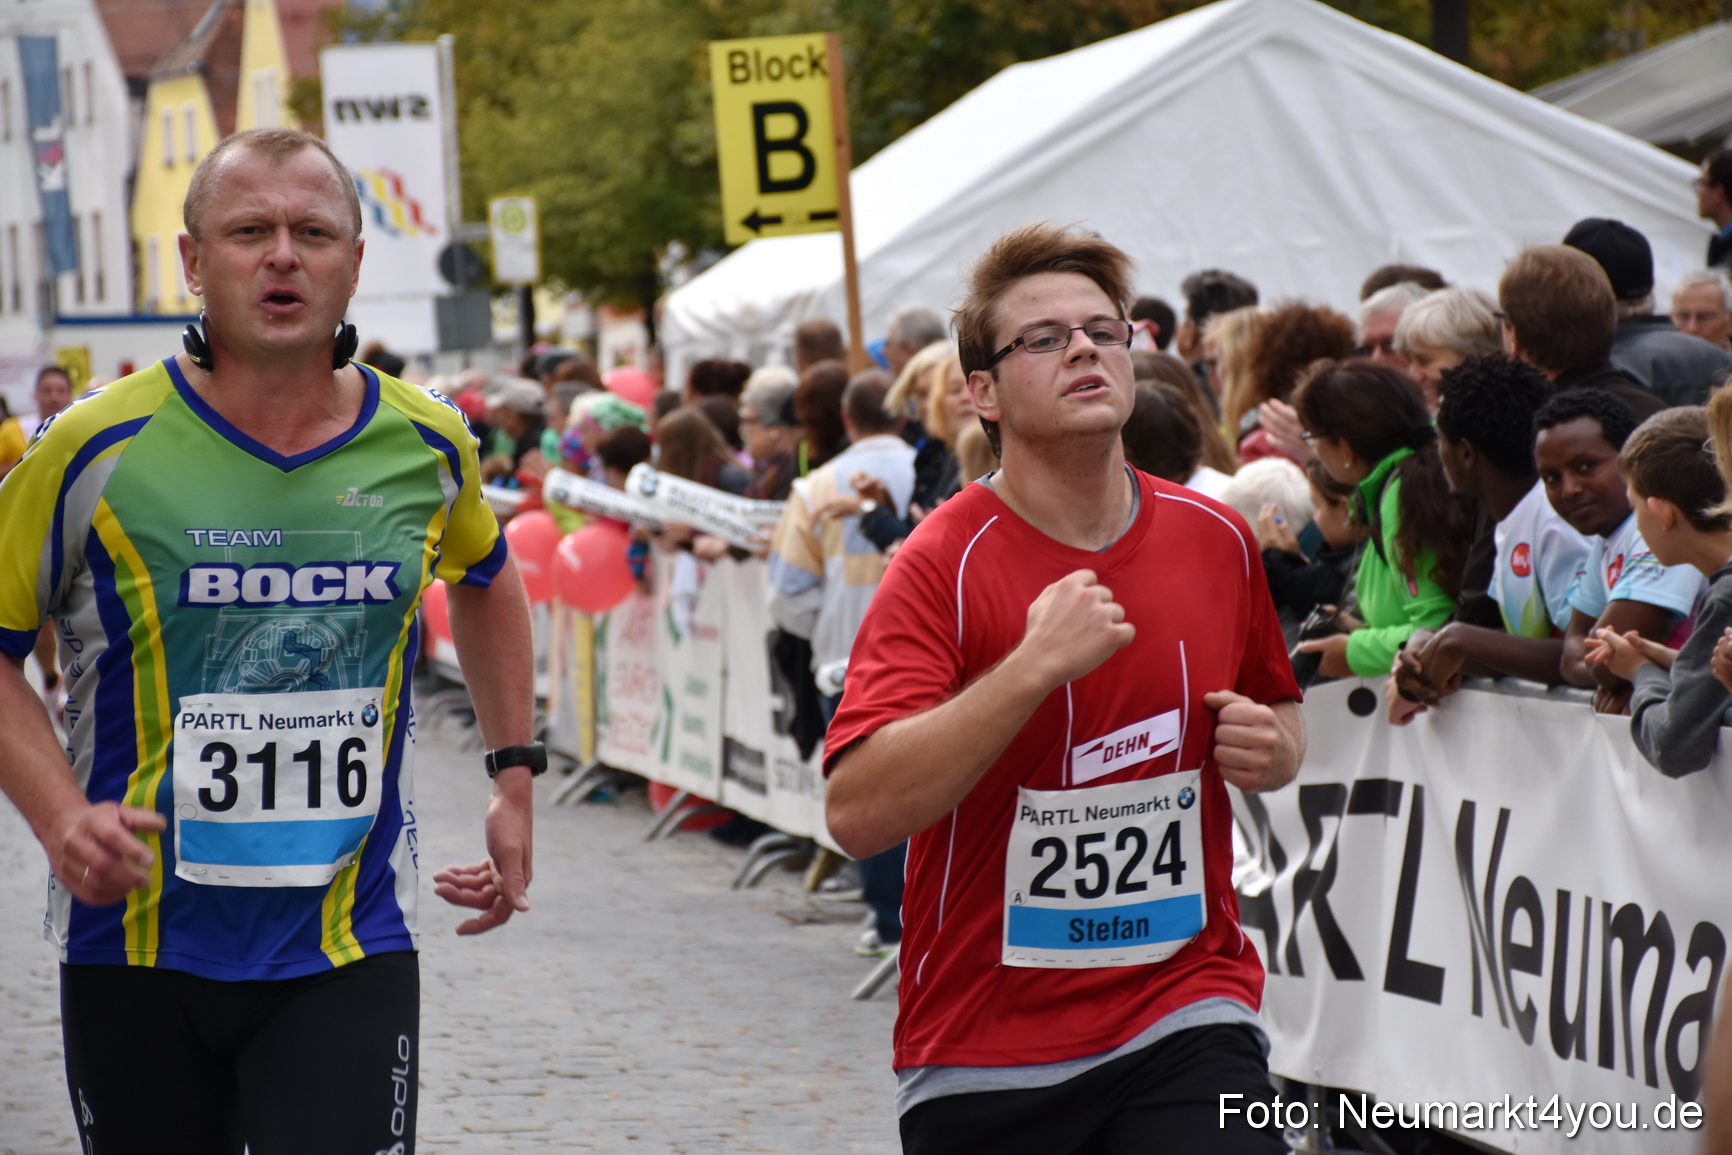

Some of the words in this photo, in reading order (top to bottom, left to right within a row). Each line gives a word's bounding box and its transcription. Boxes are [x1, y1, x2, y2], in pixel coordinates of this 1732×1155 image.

[727, 45, 829, 85] Block
[751, 100, 817, 195] B
[185, 529, 283, 547] TEAM
[180, 561, 401, 608] BOCK
[181, 712, 253, 731] PARTL
[259, 710, 355, 731] Neumarkt
[1102, 731, 1151, 765] DEHN
[198, 736, 367, 813] 3116
[1020, 804, 1080, 828] PARTL
[1085, 794, 1171, 823] Neumarkt
[1029, 820, 1187, 900] 2524
[1013, 892, 1023, 904] A
[1068, 915, 1149, 943] Stefan
[1235, 778, 1447, 1007] ARTL
[1455, 798, 1727, 1105] Neuma
[391, 1034, 410, 1137] odlo
